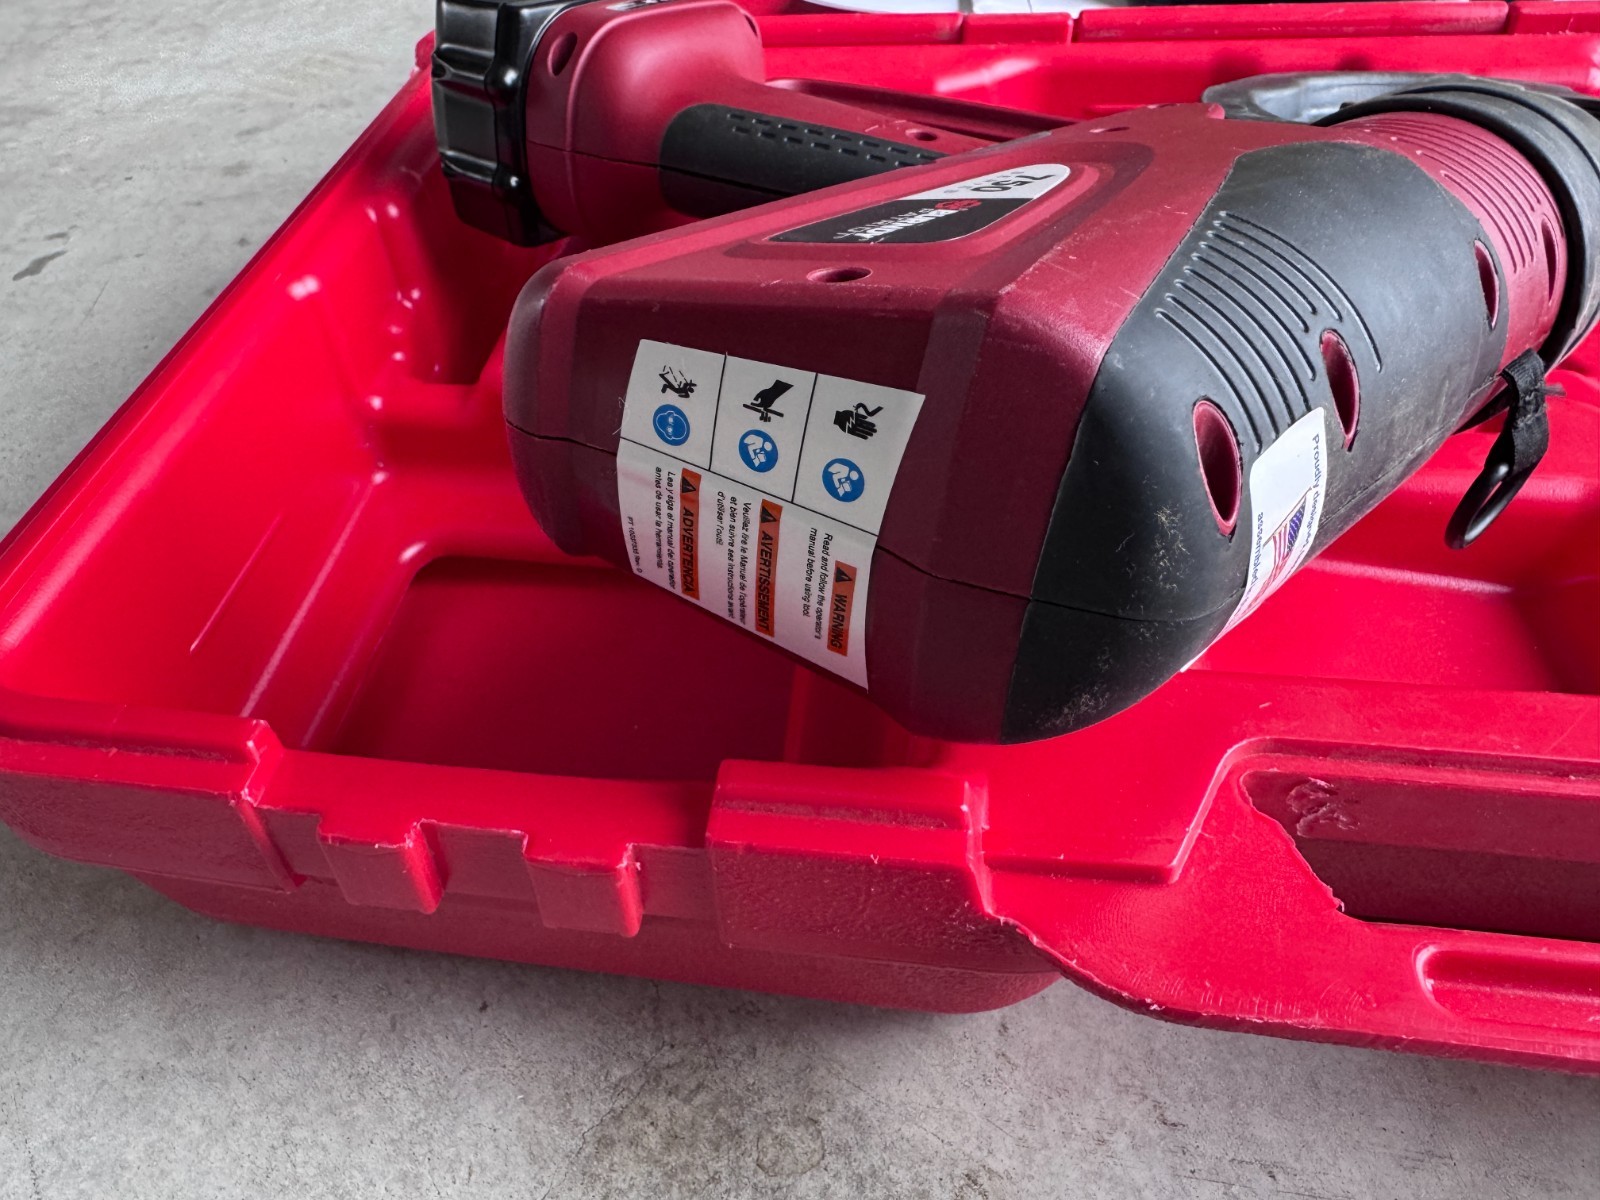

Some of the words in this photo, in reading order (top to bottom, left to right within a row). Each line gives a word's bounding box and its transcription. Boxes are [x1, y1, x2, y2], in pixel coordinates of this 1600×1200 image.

[970, 175, 1056, 192] 750
[1312, 433, 1321, 489] Proudly
[667, 471, 675, 487] Lea
[656, 490, 663, 499] de
[666, 495, 675, 510] siga
[730, 497, 738, 505] et
[656, 520, 662, 528] la
[667, 513, 675, 521] el
[729, 507, 737, 522] bien
[742, 502, 751, 532] Veuillez
[667, 522, 675, 548] manual
[728, 524, 736, 547] suivre
[741, 533, 749, 544] lire
[808, 528, 817, 557] manual
[822, 533, 833, 556] Read
[683, 507, 695, 593] ADVERTENCIA
[1251, 512, 1264, 585] assembled
[740, 555, 748, 581] Manuel
[806, 558, 814, 582] before
[821, 556, 830, 570] and
[727, 563, 736, 600] instructions
[740, 582, 747, 591] de
[758, 531, 773, 631] AVERTISSEMENT
[818, 572, 828, 594] follow
[802, 584, 812, 602] using
[817, 595, 825, 606] the
[831, 594, 847, 649] WARNING
